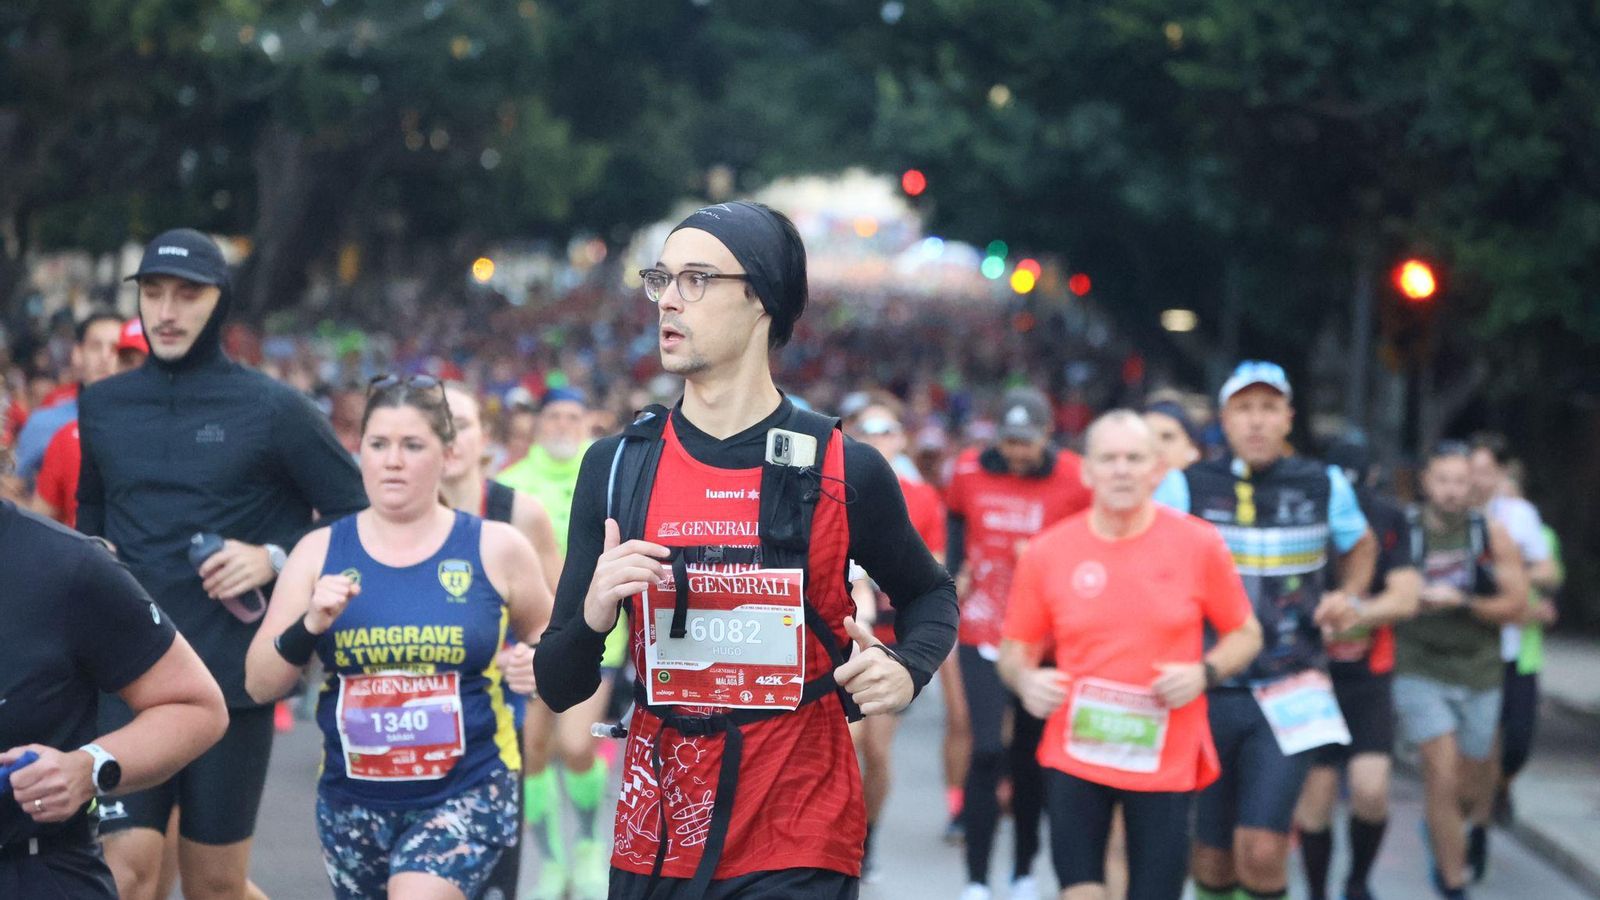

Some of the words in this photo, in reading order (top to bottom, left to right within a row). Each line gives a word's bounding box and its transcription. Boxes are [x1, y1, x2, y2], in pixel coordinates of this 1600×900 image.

[705, 488, 745, 499] luanvi
[681, 520, 759, 537] GENERALI
[688, 576, 791, 597] GENERALI
[335, 625, 464, 648] WARGRAVE
[690, 617, 762, 644] 6082
[335, 649, 351, 667] &
[351, 645, 466, 665] TWYFORD
[712, 646, 742, 656] HUGO
[371, 676, 449, 695] GENERALI
[755, 675, 783, 685] 42K
[371, 709, 429, 733] 1340
